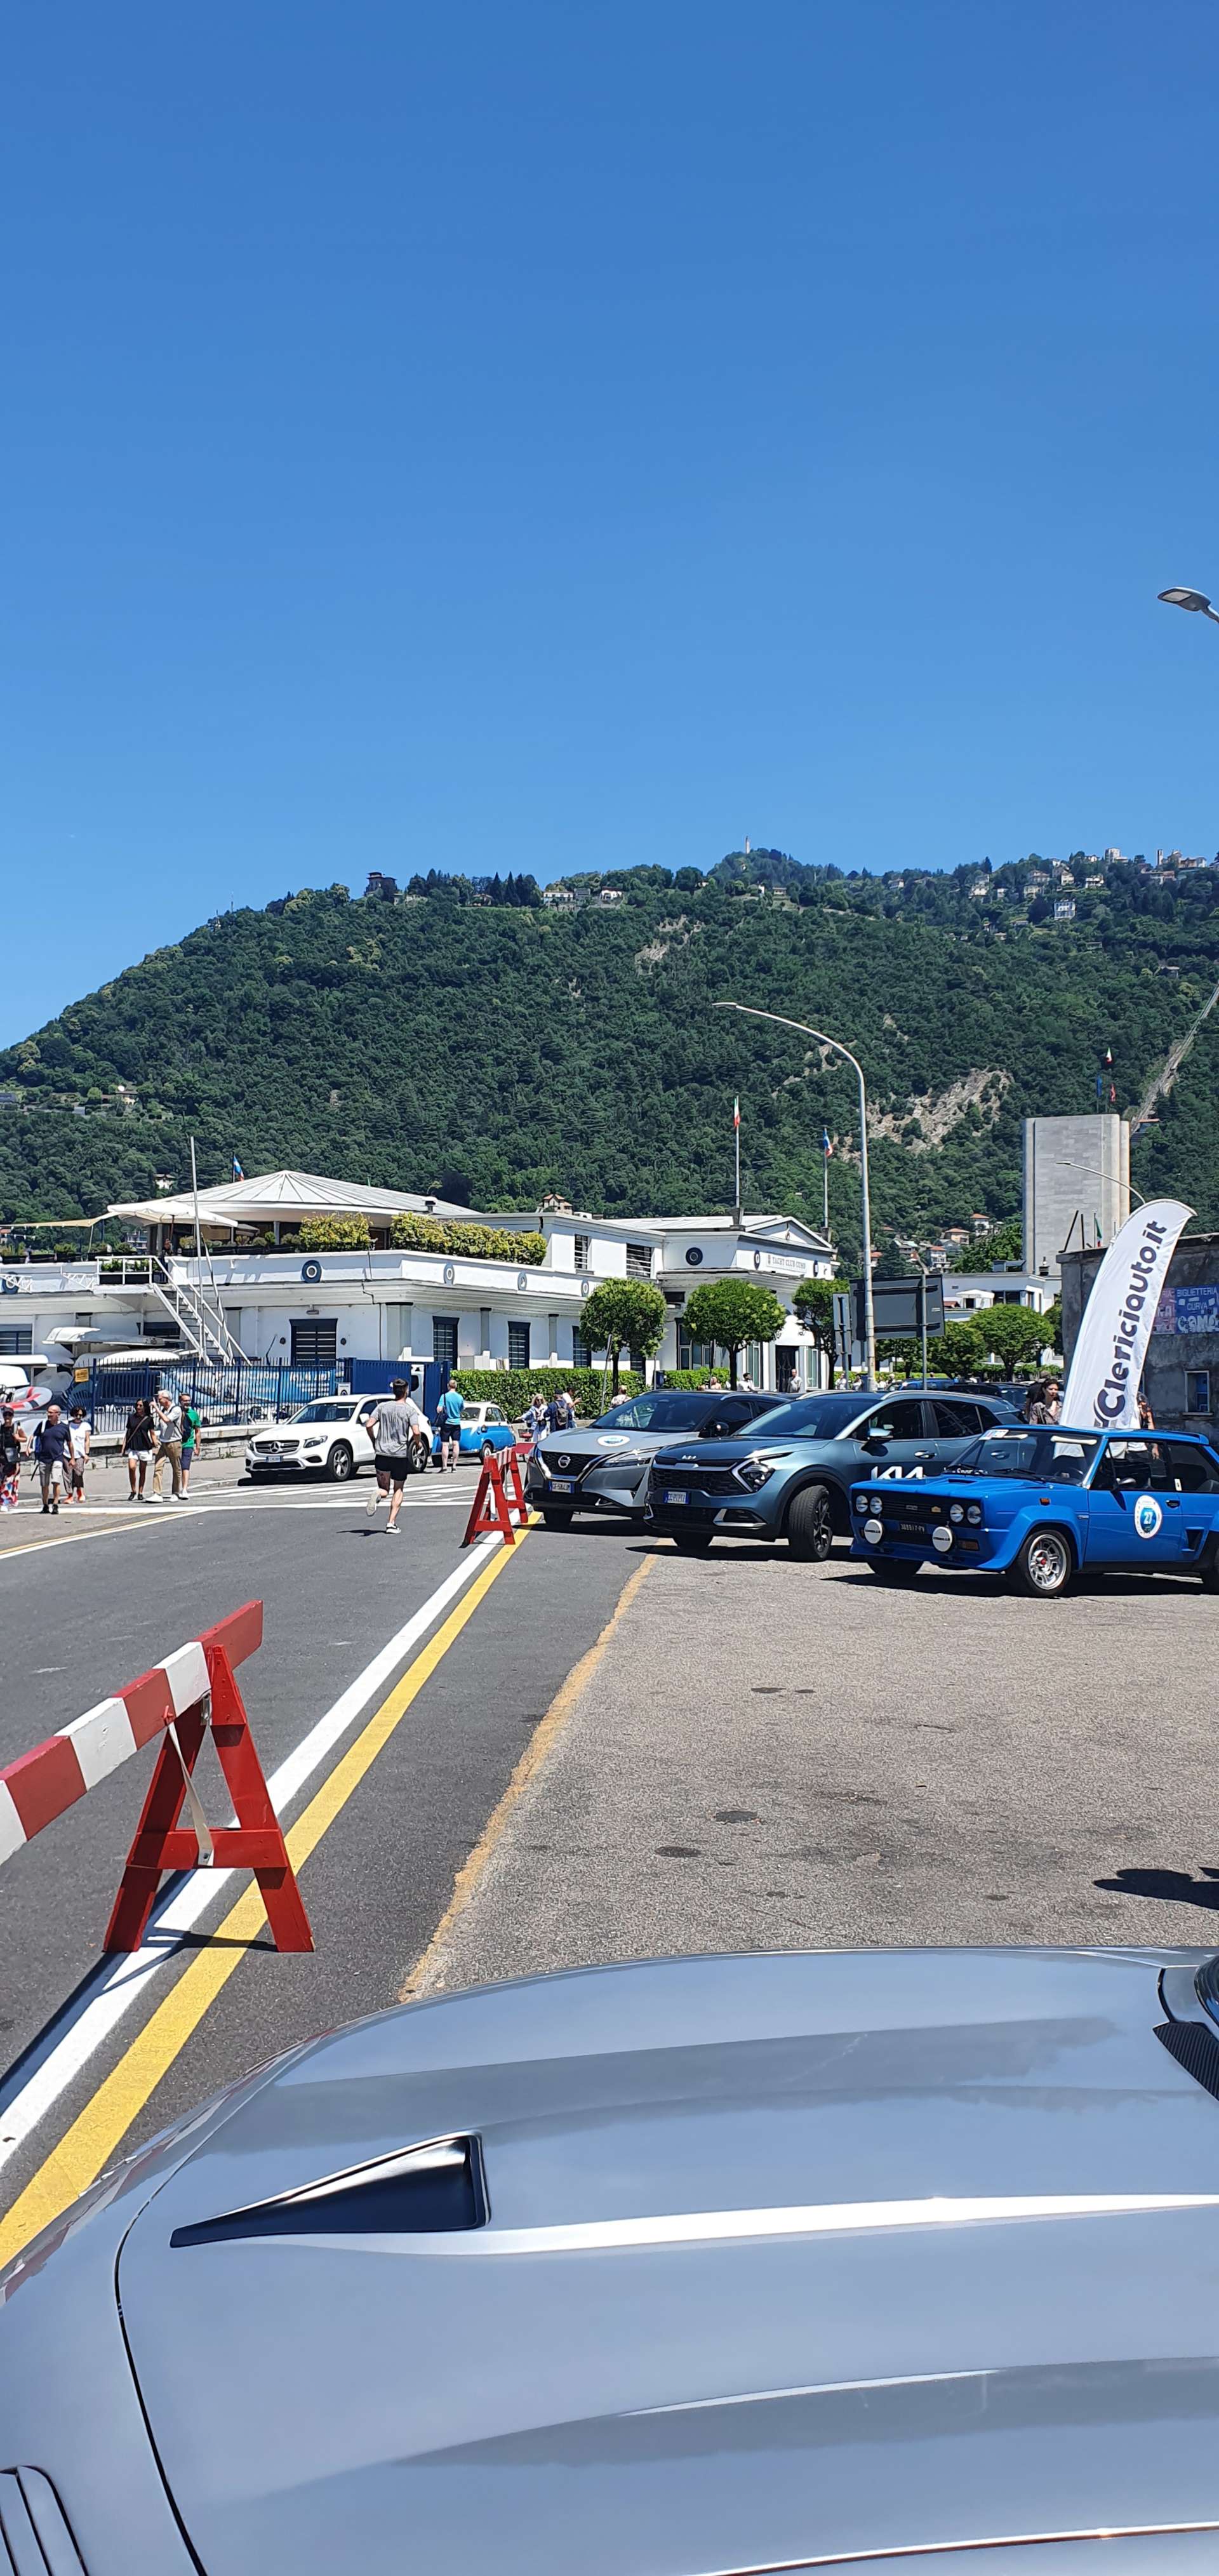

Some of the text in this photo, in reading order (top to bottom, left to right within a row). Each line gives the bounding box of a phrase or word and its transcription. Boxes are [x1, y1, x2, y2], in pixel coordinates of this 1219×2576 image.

[1176, 1287, 1217, 1297] BIGLIETTERIA
[1187, 1302, 1208, 1311] CURVA
[1097, 1220, 1167, 1418] Clericiauto.it
[1143, 1511, 1154, 1525] 27
